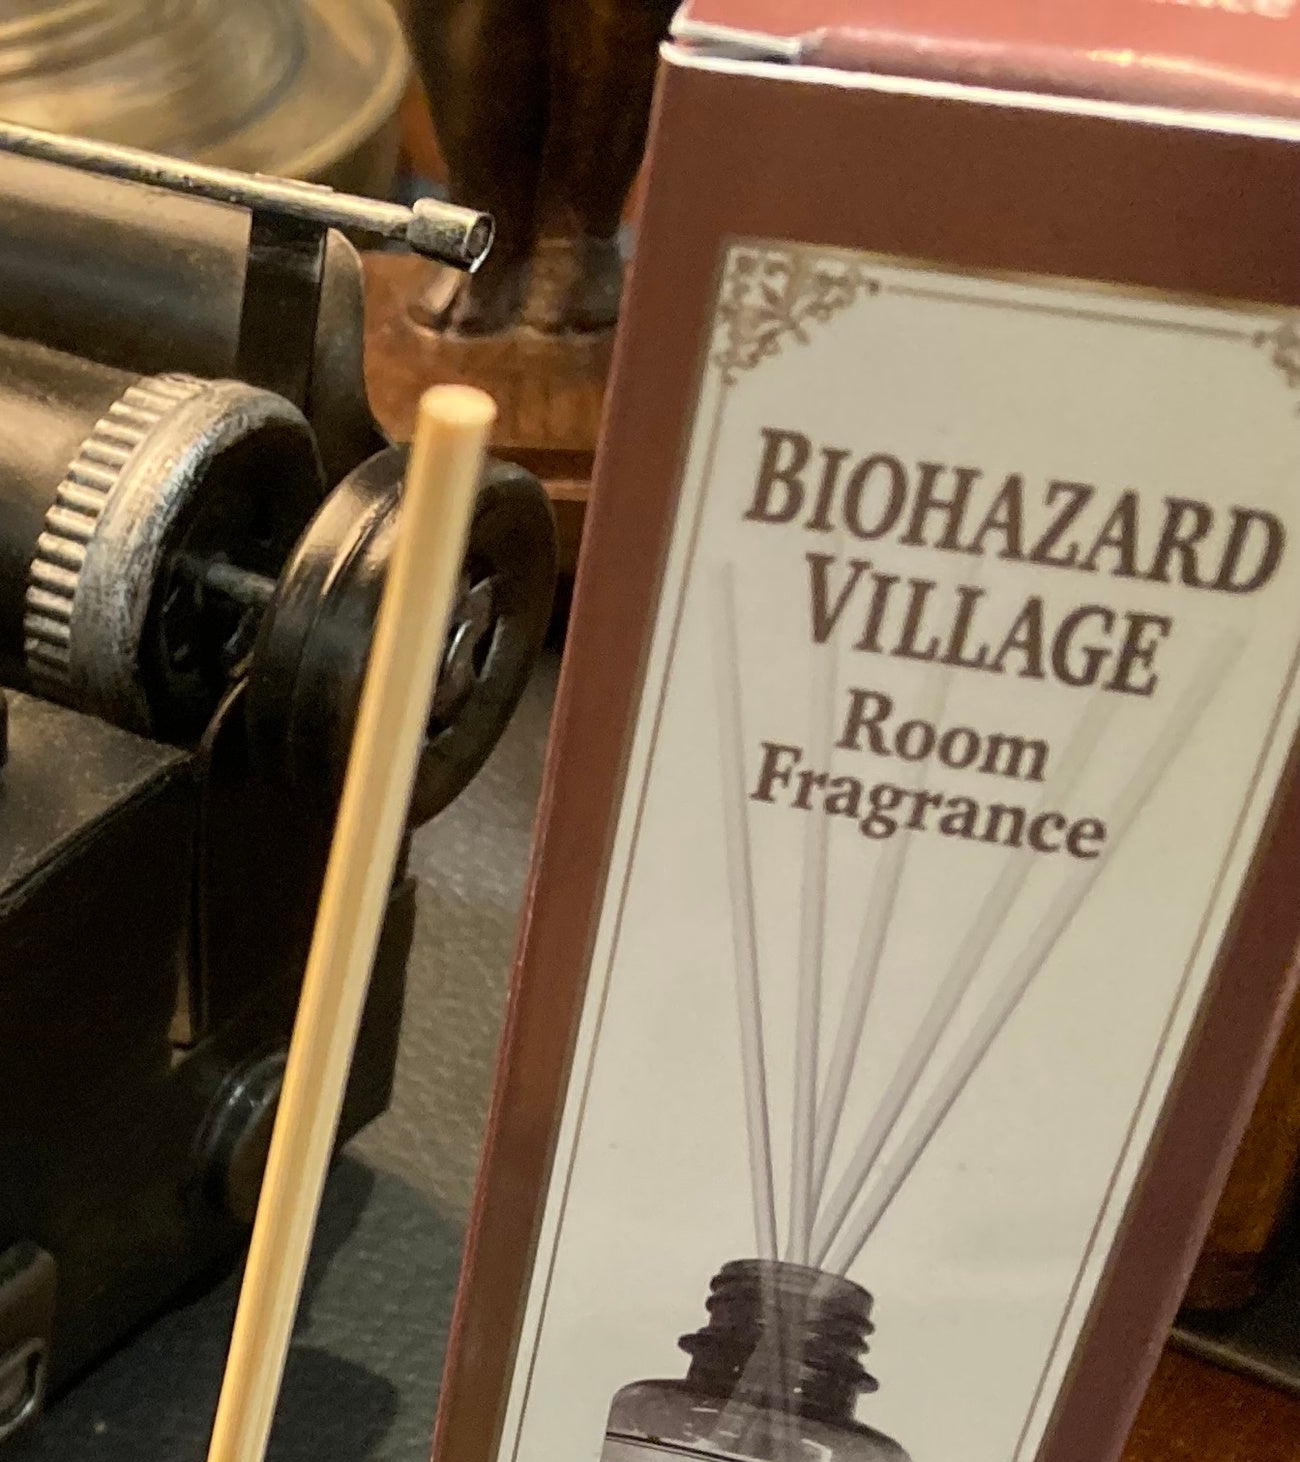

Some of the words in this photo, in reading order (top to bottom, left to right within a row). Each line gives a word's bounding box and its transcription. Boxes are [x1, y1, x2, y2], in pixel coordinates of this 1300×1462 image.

[743, 426, 1287, 596] BIOHAZARD
[804, 552, 1173, 697] VILLAGE
[749, 741, 1109, 860] Fragrance
[835, 687, 1050, 782] Room
